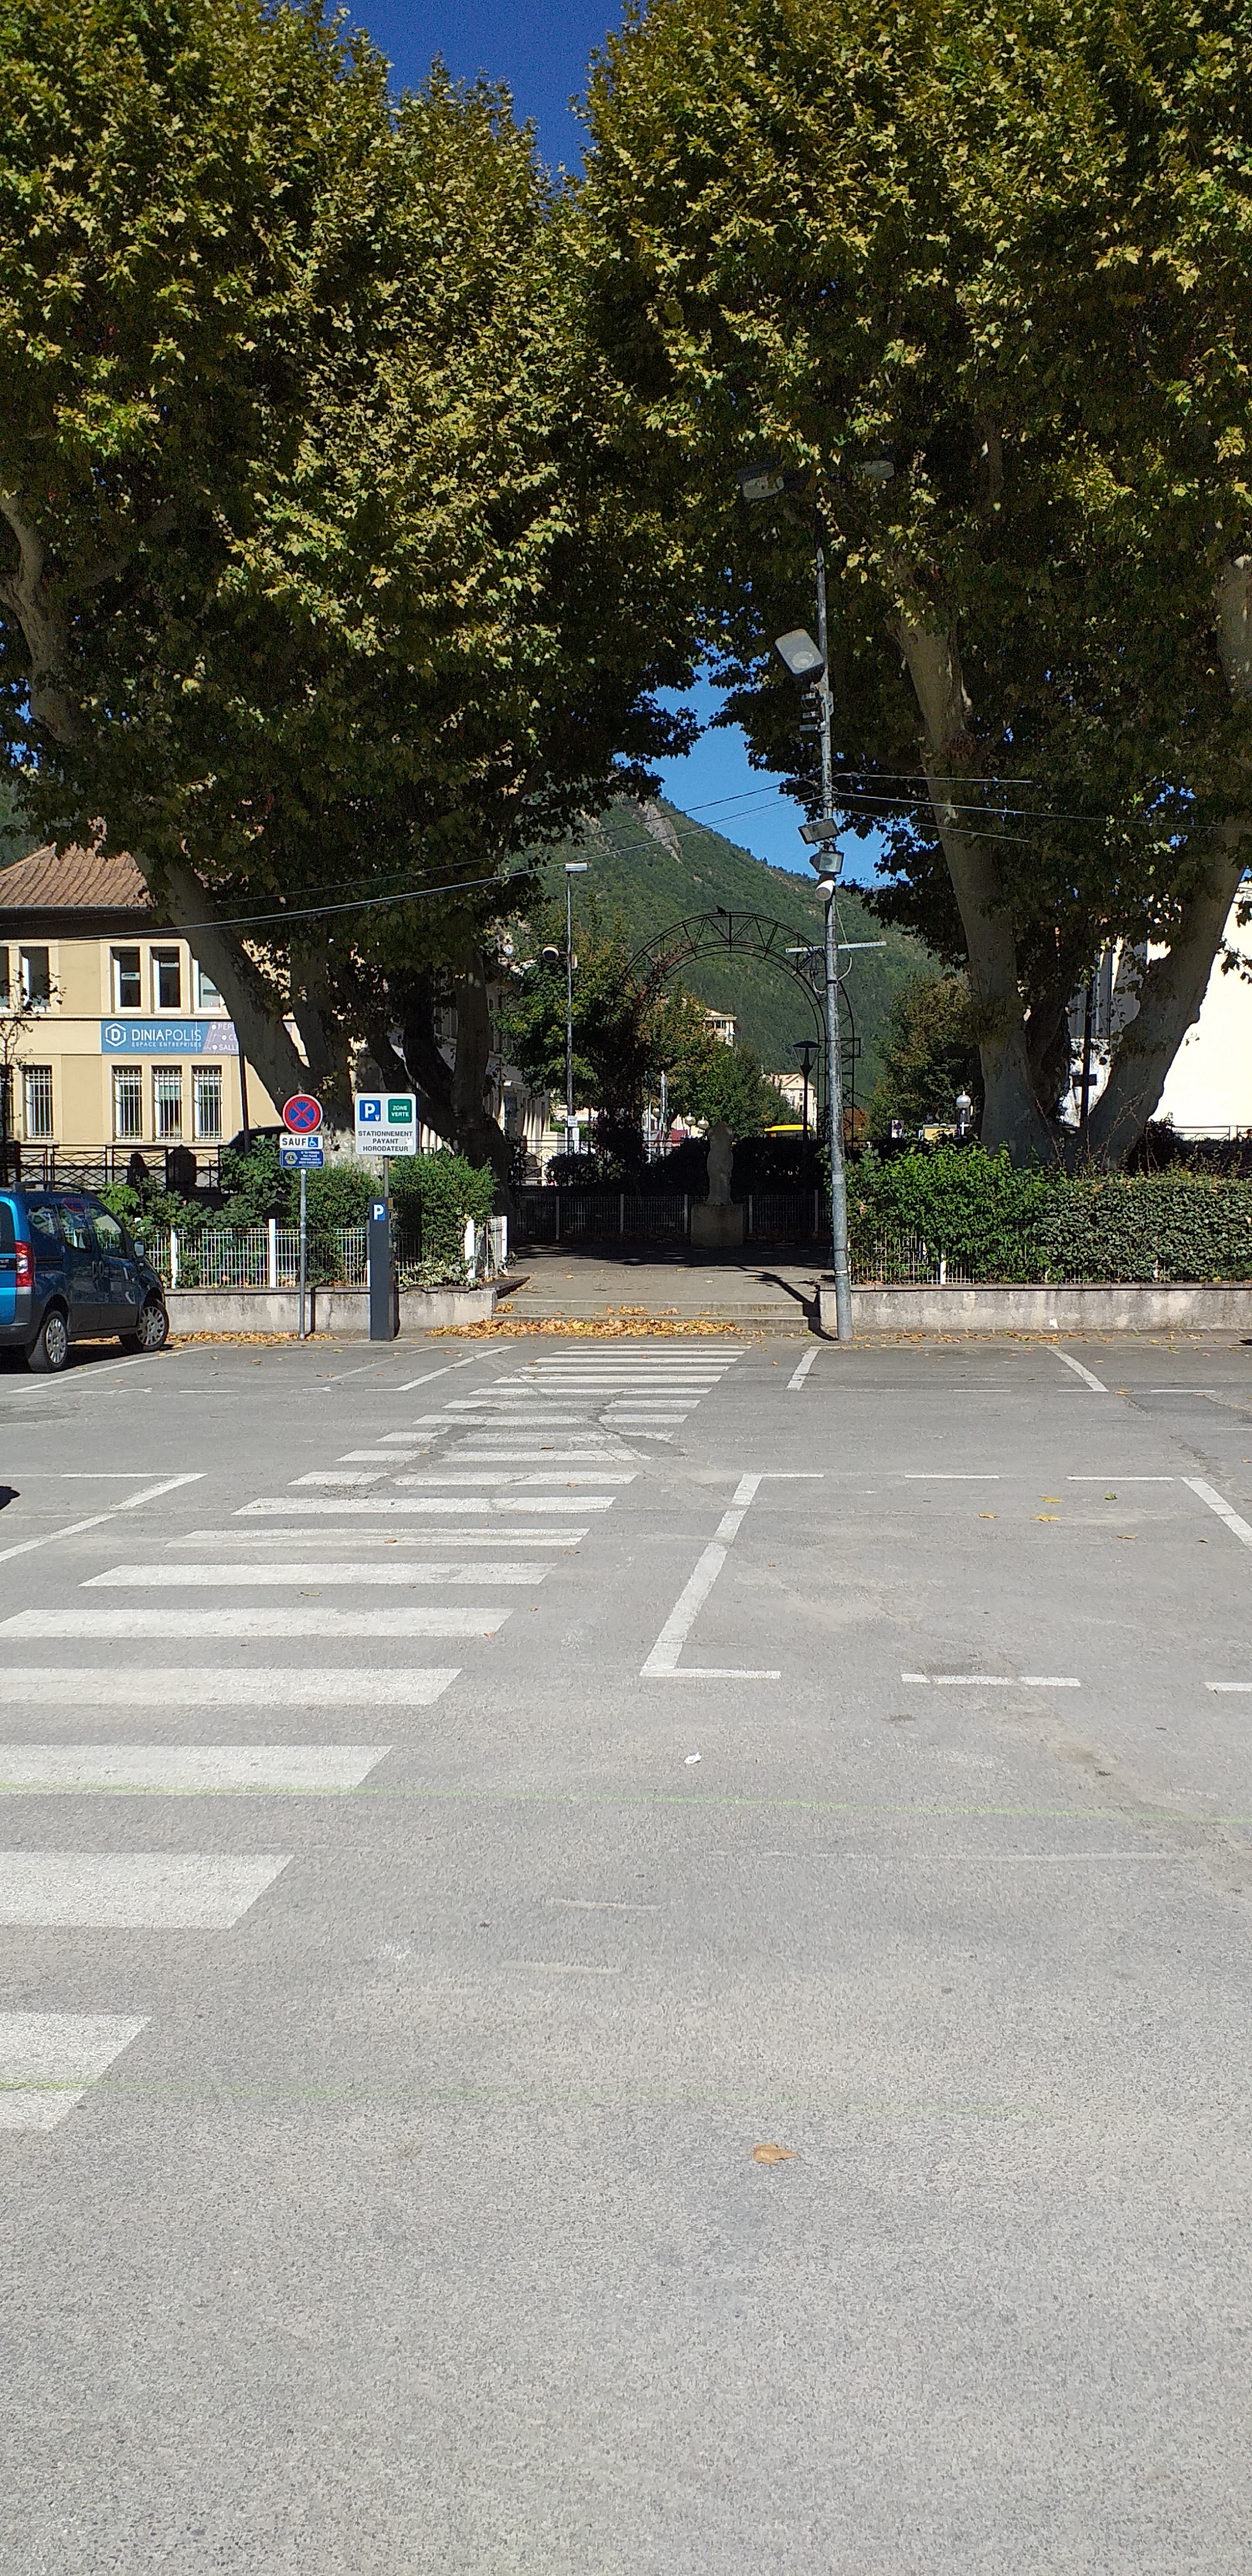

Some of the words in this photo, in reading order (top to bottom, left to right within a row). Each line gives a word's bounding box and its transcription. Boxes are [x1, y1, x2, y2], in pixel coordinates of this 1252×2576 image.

[111, 1029, 121, 1041] D
[132, 1029, 202, 1041] DINIAPOLIS
[365, 1103, 376, 1119] P
[282, 1137, 307, 1146] SAUF
[374, 1204, 384, 1220] P
